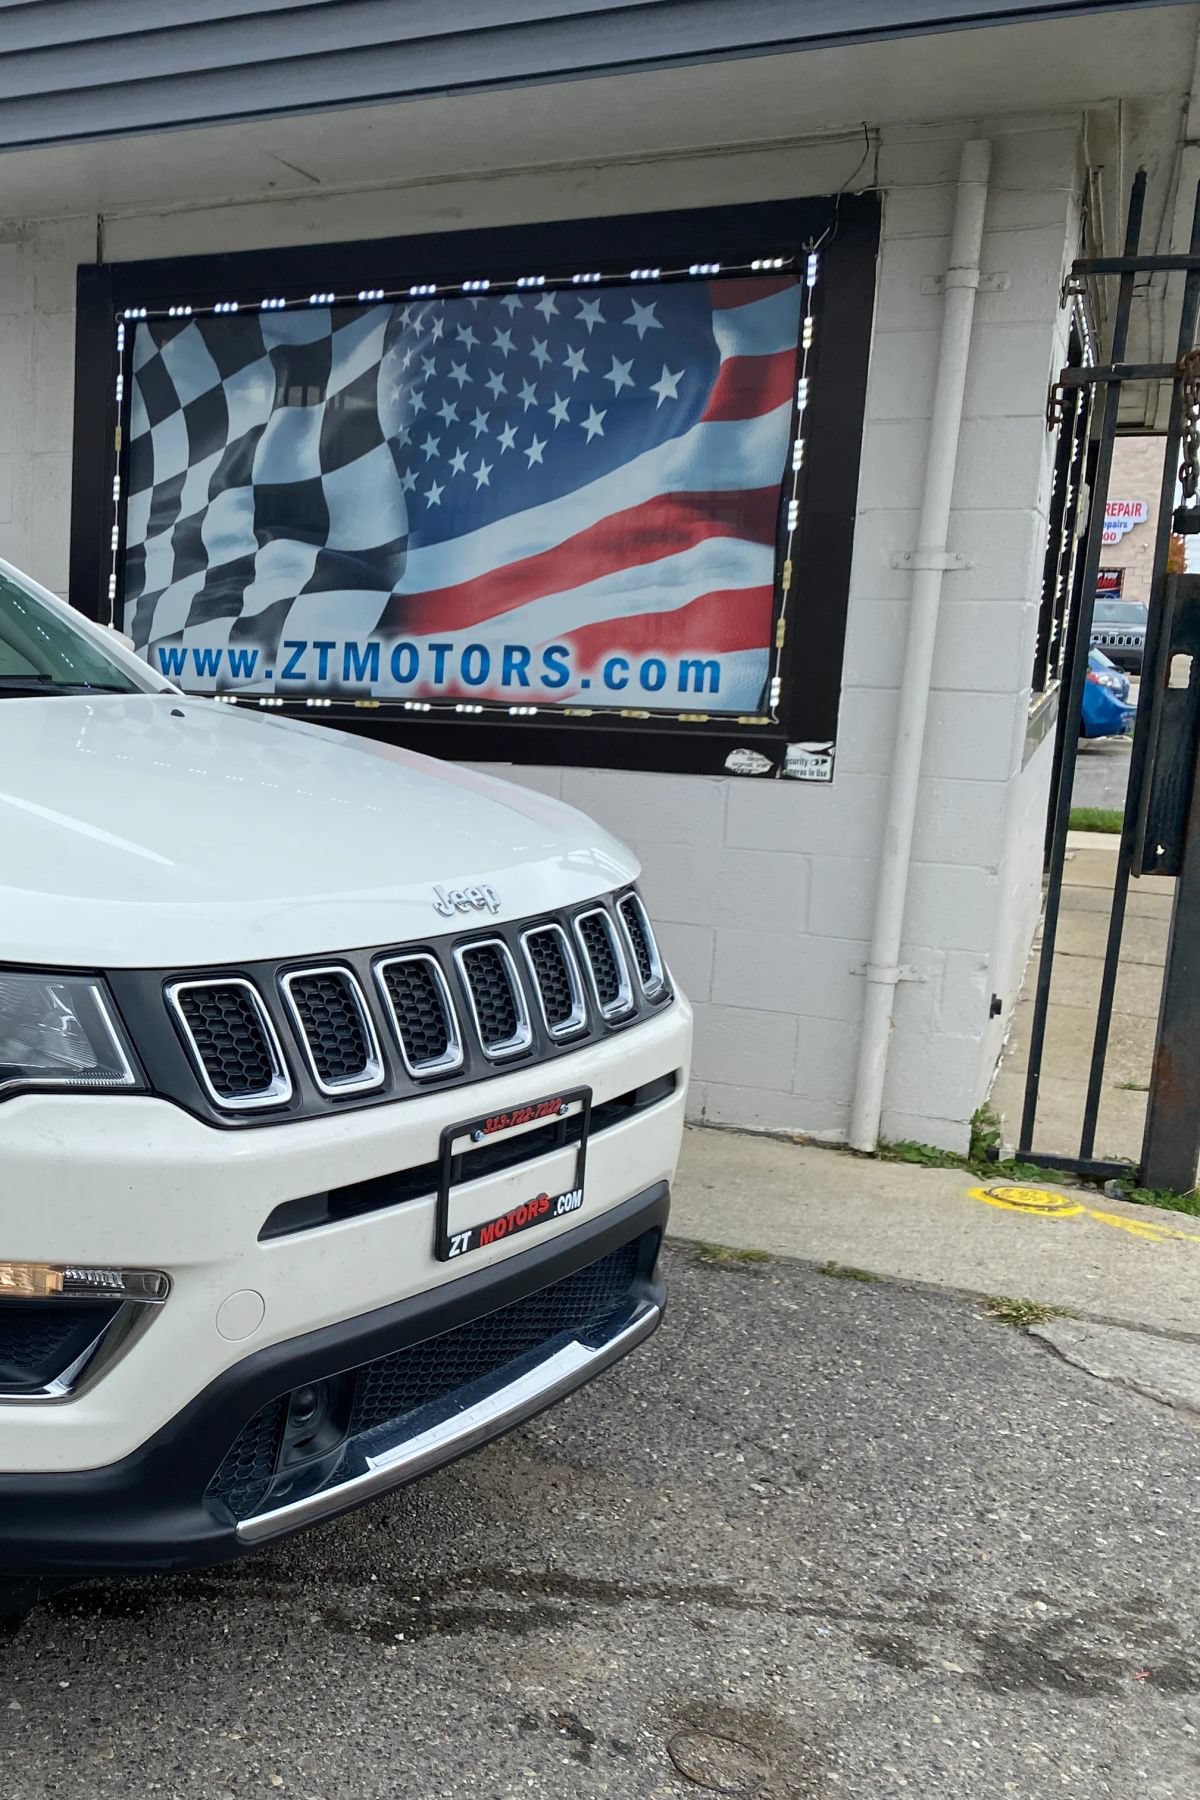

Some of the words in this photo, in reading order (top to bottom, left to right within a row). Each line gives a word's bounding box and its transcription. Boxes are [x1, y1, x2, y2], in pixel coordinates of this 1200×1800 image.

[158, 640, 721, 693] www.ZTMOTORS.com
[785, 756, 809, 768] ecurity
[787, 768, 807, 777] meras
[432, 883, 502, 918] Jeep
[448, 1230, 473, 1258] ZT
[479, 1192, 551, 1248] MOTORS
[553, 1189, 583, 1217] .COM
